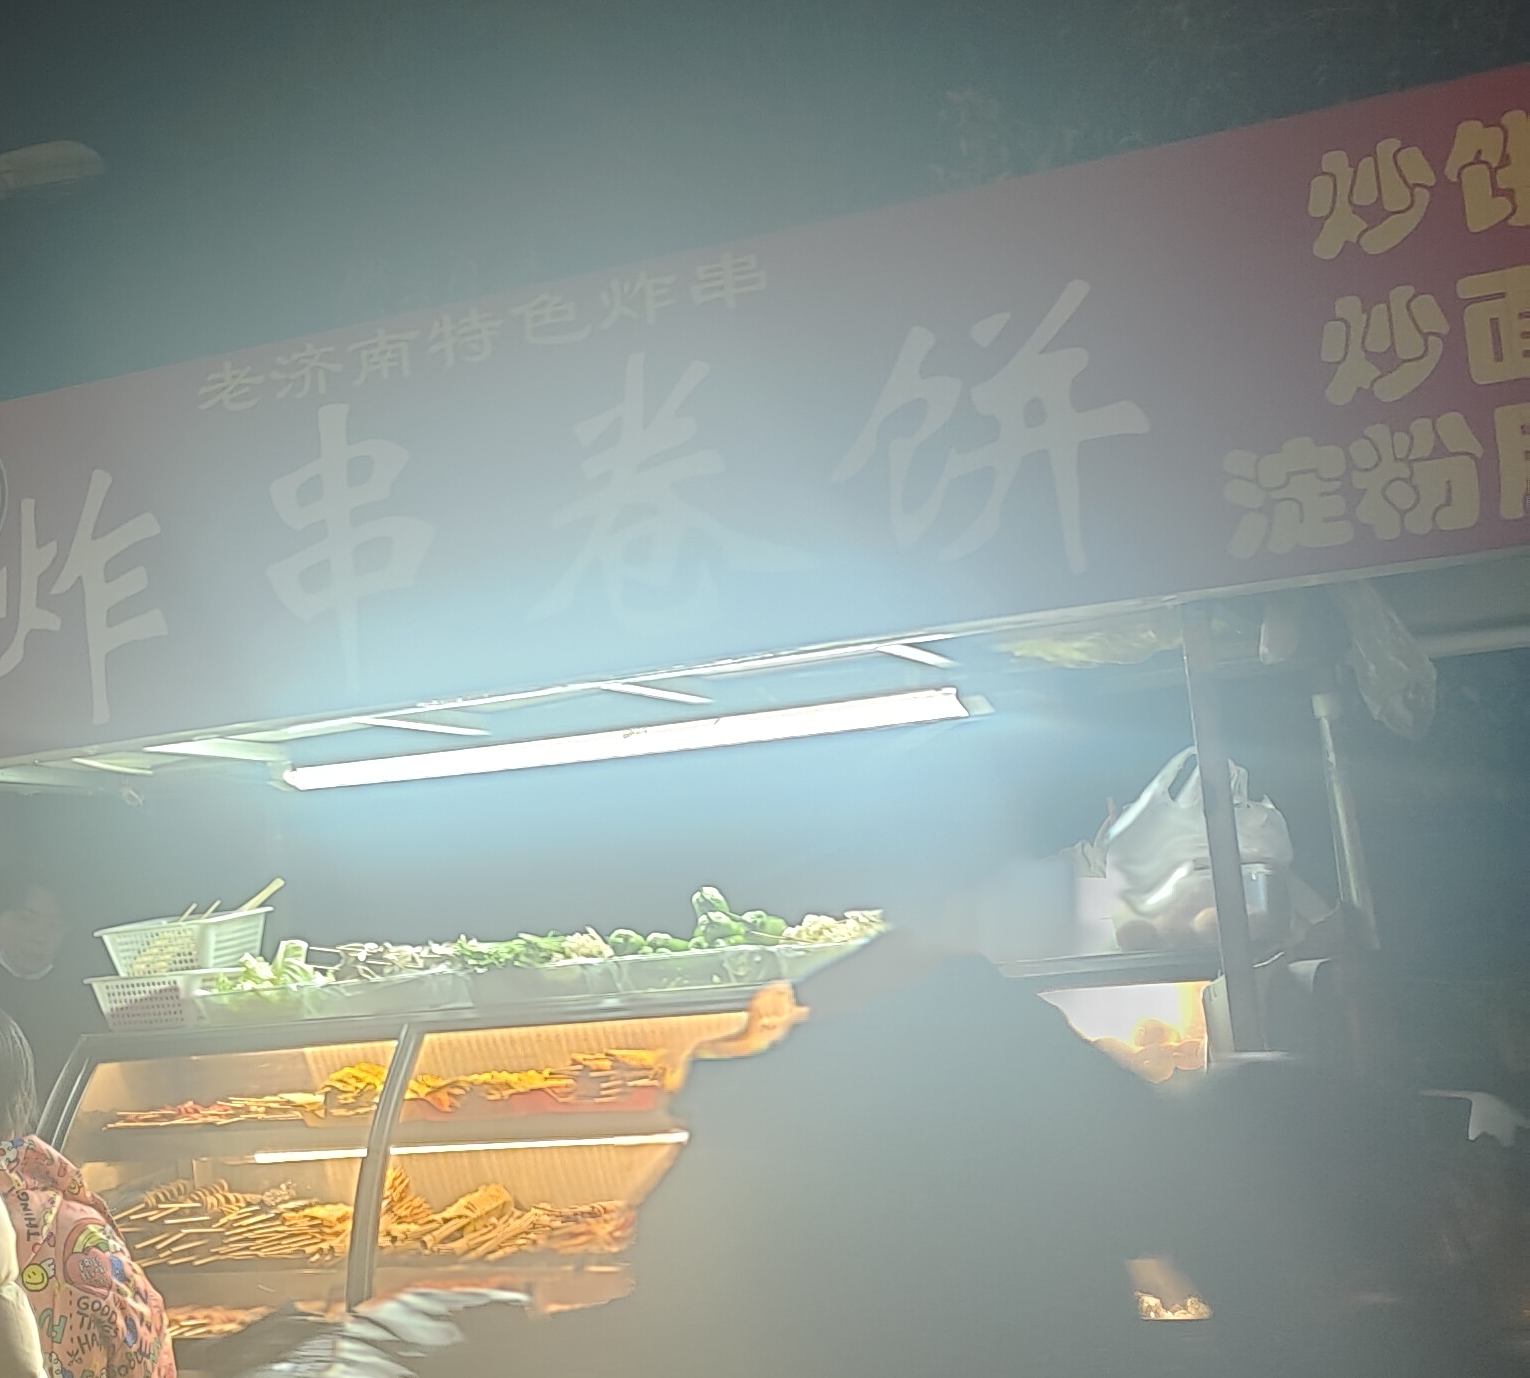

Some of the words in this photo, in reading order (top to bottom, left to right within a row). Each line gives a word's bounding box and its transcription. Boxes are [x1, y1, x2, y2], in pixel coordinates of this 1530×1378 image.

[197, 251, 768, 412] 老济南特色炸串
[76, 1295, 118, 1324] GOOD
